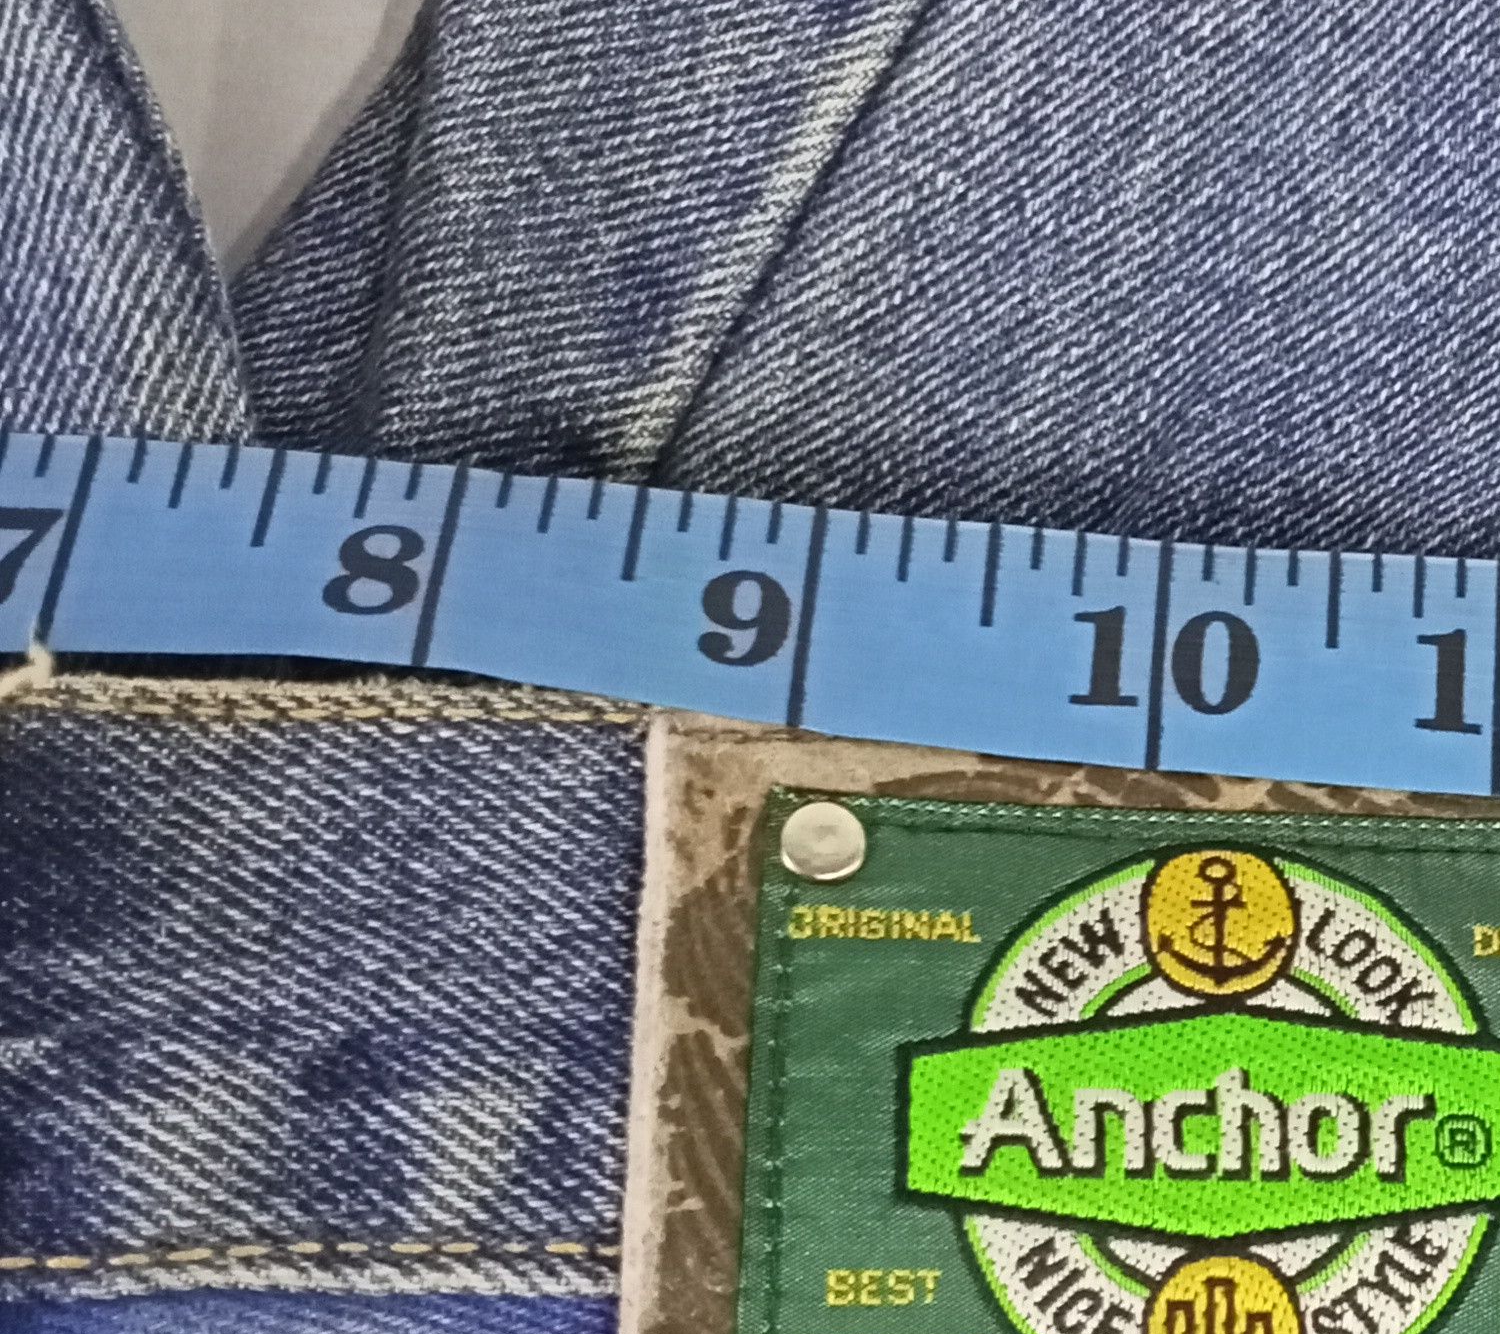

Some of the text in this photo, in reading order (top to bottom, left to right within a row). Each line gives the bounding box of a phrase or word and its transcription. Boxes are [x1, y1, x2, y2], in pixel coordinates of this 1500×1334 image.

[322, 524, 425, 616] 8
[696, 570, 793, 667] 9
[1068, 606, 1261, 715] 10
[787, 904, 982, 944] ORIGINAL
[1013, 907, 1437, 1025] NEW LOOK
[825, 1269, 942, 1307] BEST
